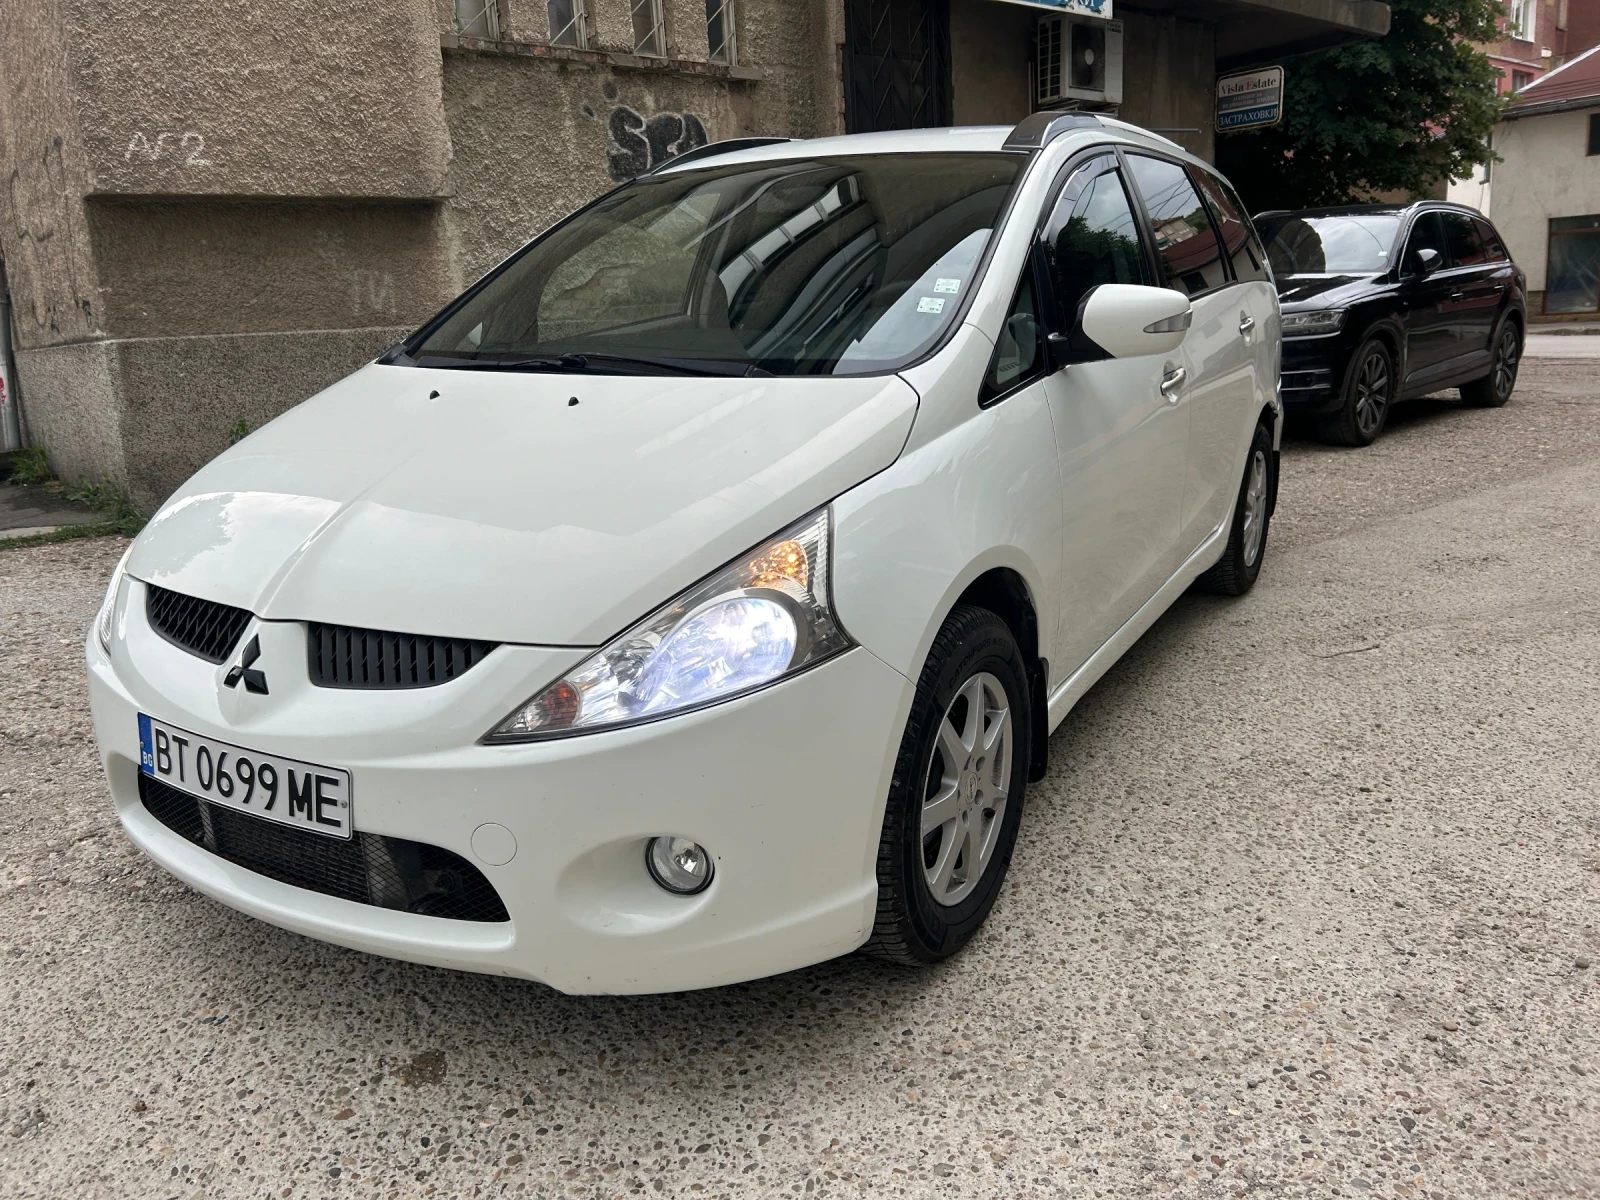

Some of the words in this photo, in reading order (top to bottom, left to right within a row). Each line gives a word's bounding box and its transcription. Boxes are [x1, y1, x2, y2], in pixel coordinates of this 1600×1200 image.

[1221, 83, 1244, 94] Vista
[1246, 78, 1276, 91] Estate
[1220, 108, 1277, 125] ЗАСТРАХОВКИ
[142, 752, 153, 767] BG
[155, 726, 189, 782] BT
[196, 744, 278, 811] 0699
[288, 767, 341, 828] ME
